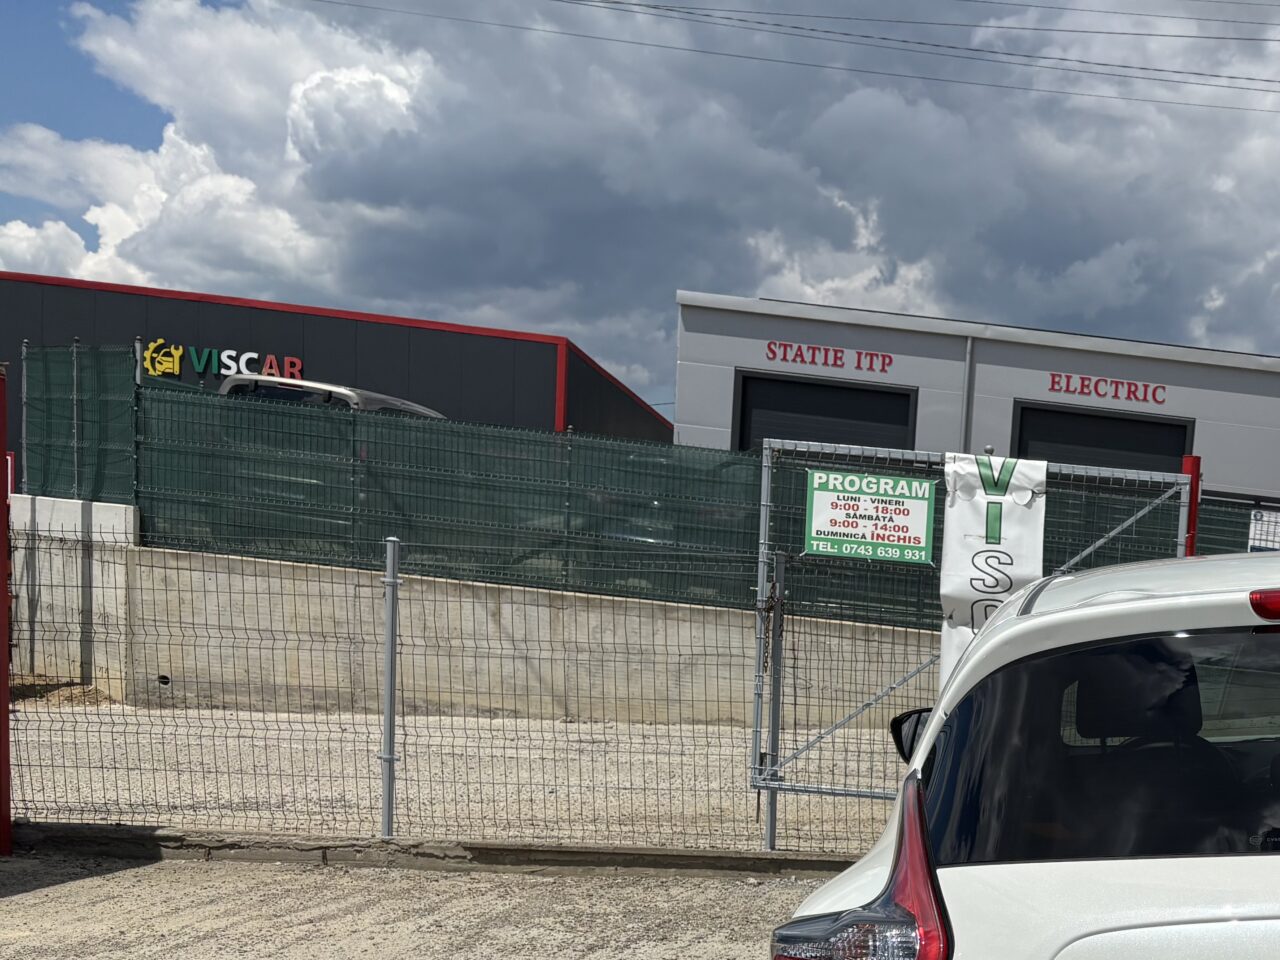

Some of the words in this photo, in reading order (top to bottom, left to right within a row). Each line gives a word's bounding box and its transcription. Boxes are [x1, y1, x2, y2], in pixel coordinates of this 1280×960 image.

[188, 346, 303, 380] VISCAR
[766, 341, 845, 368] STATIE
[854, 351, 893, 373] ITP
[1048, 373, 1166, 405] ELECTRIC
[813, 472, 930, 498] PROGRAM
[830, 501, 860, 512] 9:00
[873, 505, 910, 517] 18:00
[837, 494, 861, 503] LUNI
[870, 497, 905, 507] VINERI
[829, 518, 859, 529] 9:00
[872, 523, 909, 534] 14:00
[870, 531, 922, 545] ÎNCHIS
[811, 541, 838, 553] TEL:
[842, 544, 873, 556] 0743
[877, 547, 900, 558] 639
[904, 549, 926, 560] 931
